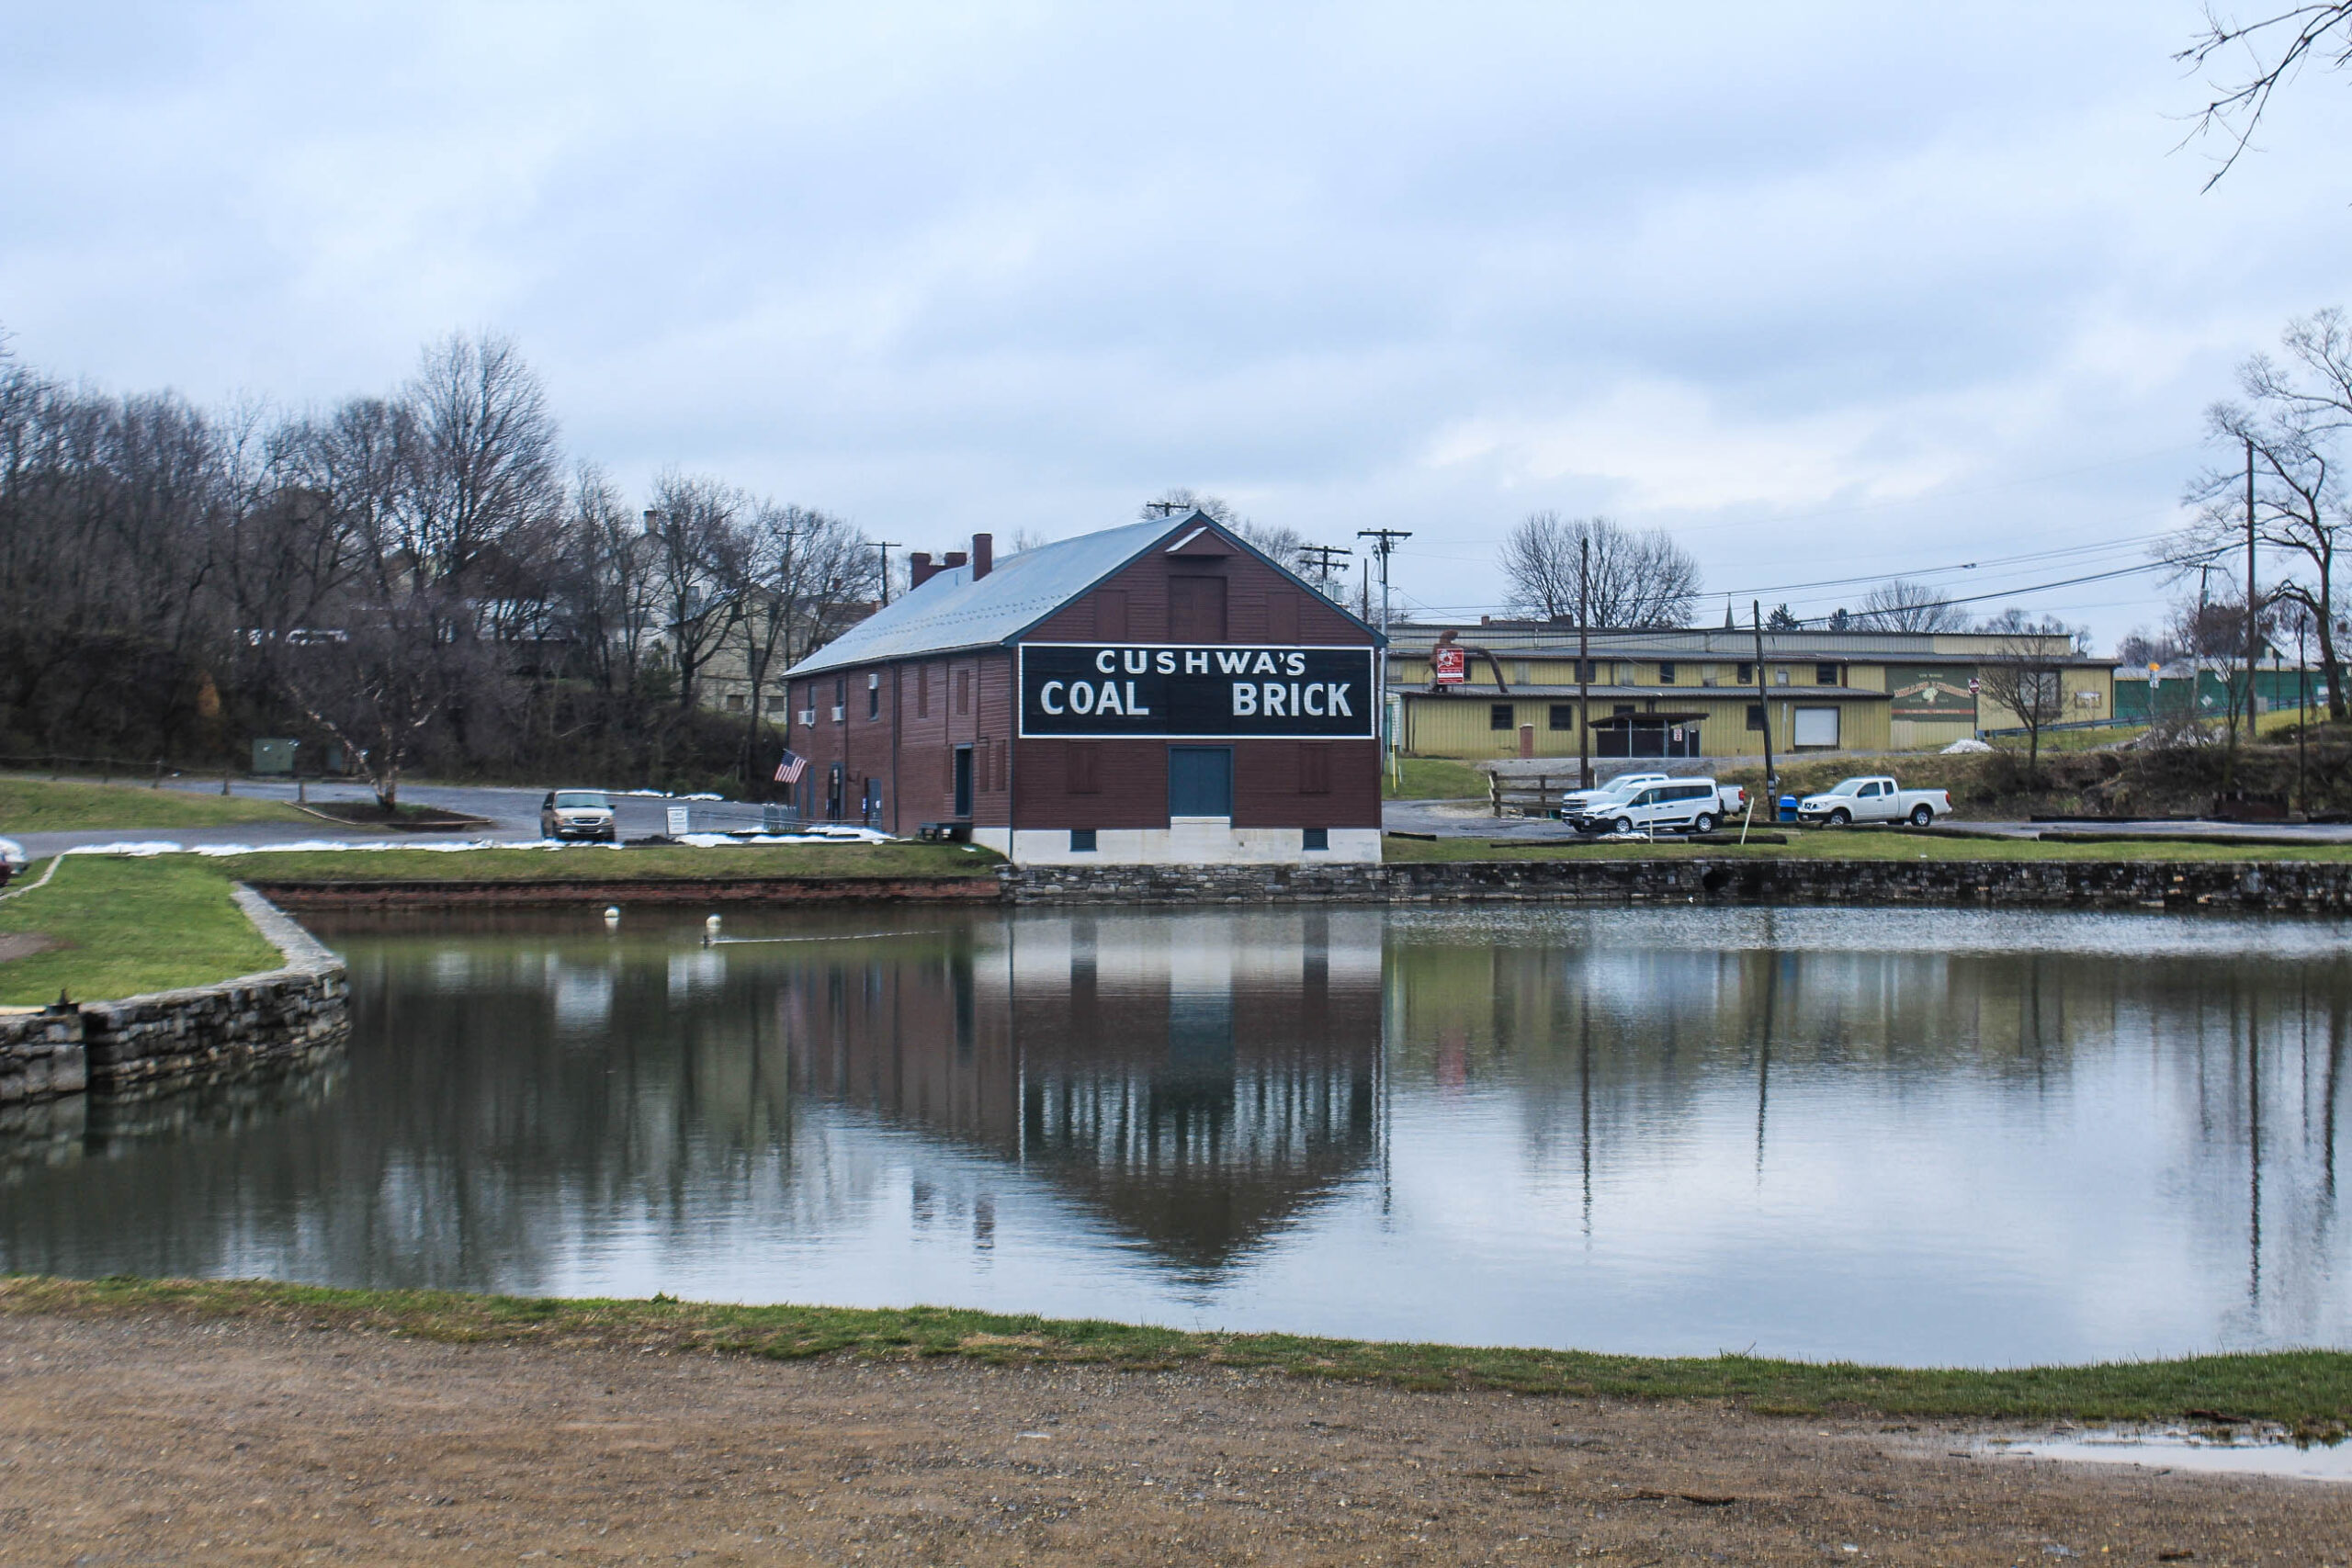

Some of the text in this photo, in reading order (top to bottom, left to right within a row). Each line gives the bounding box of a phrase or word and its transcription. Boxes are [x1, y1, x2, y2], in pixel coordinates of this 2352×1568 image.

[1096, 650, 1306, 676] CUSHWA'S
[1041, 682, 1352, 716] COAL BRICK
